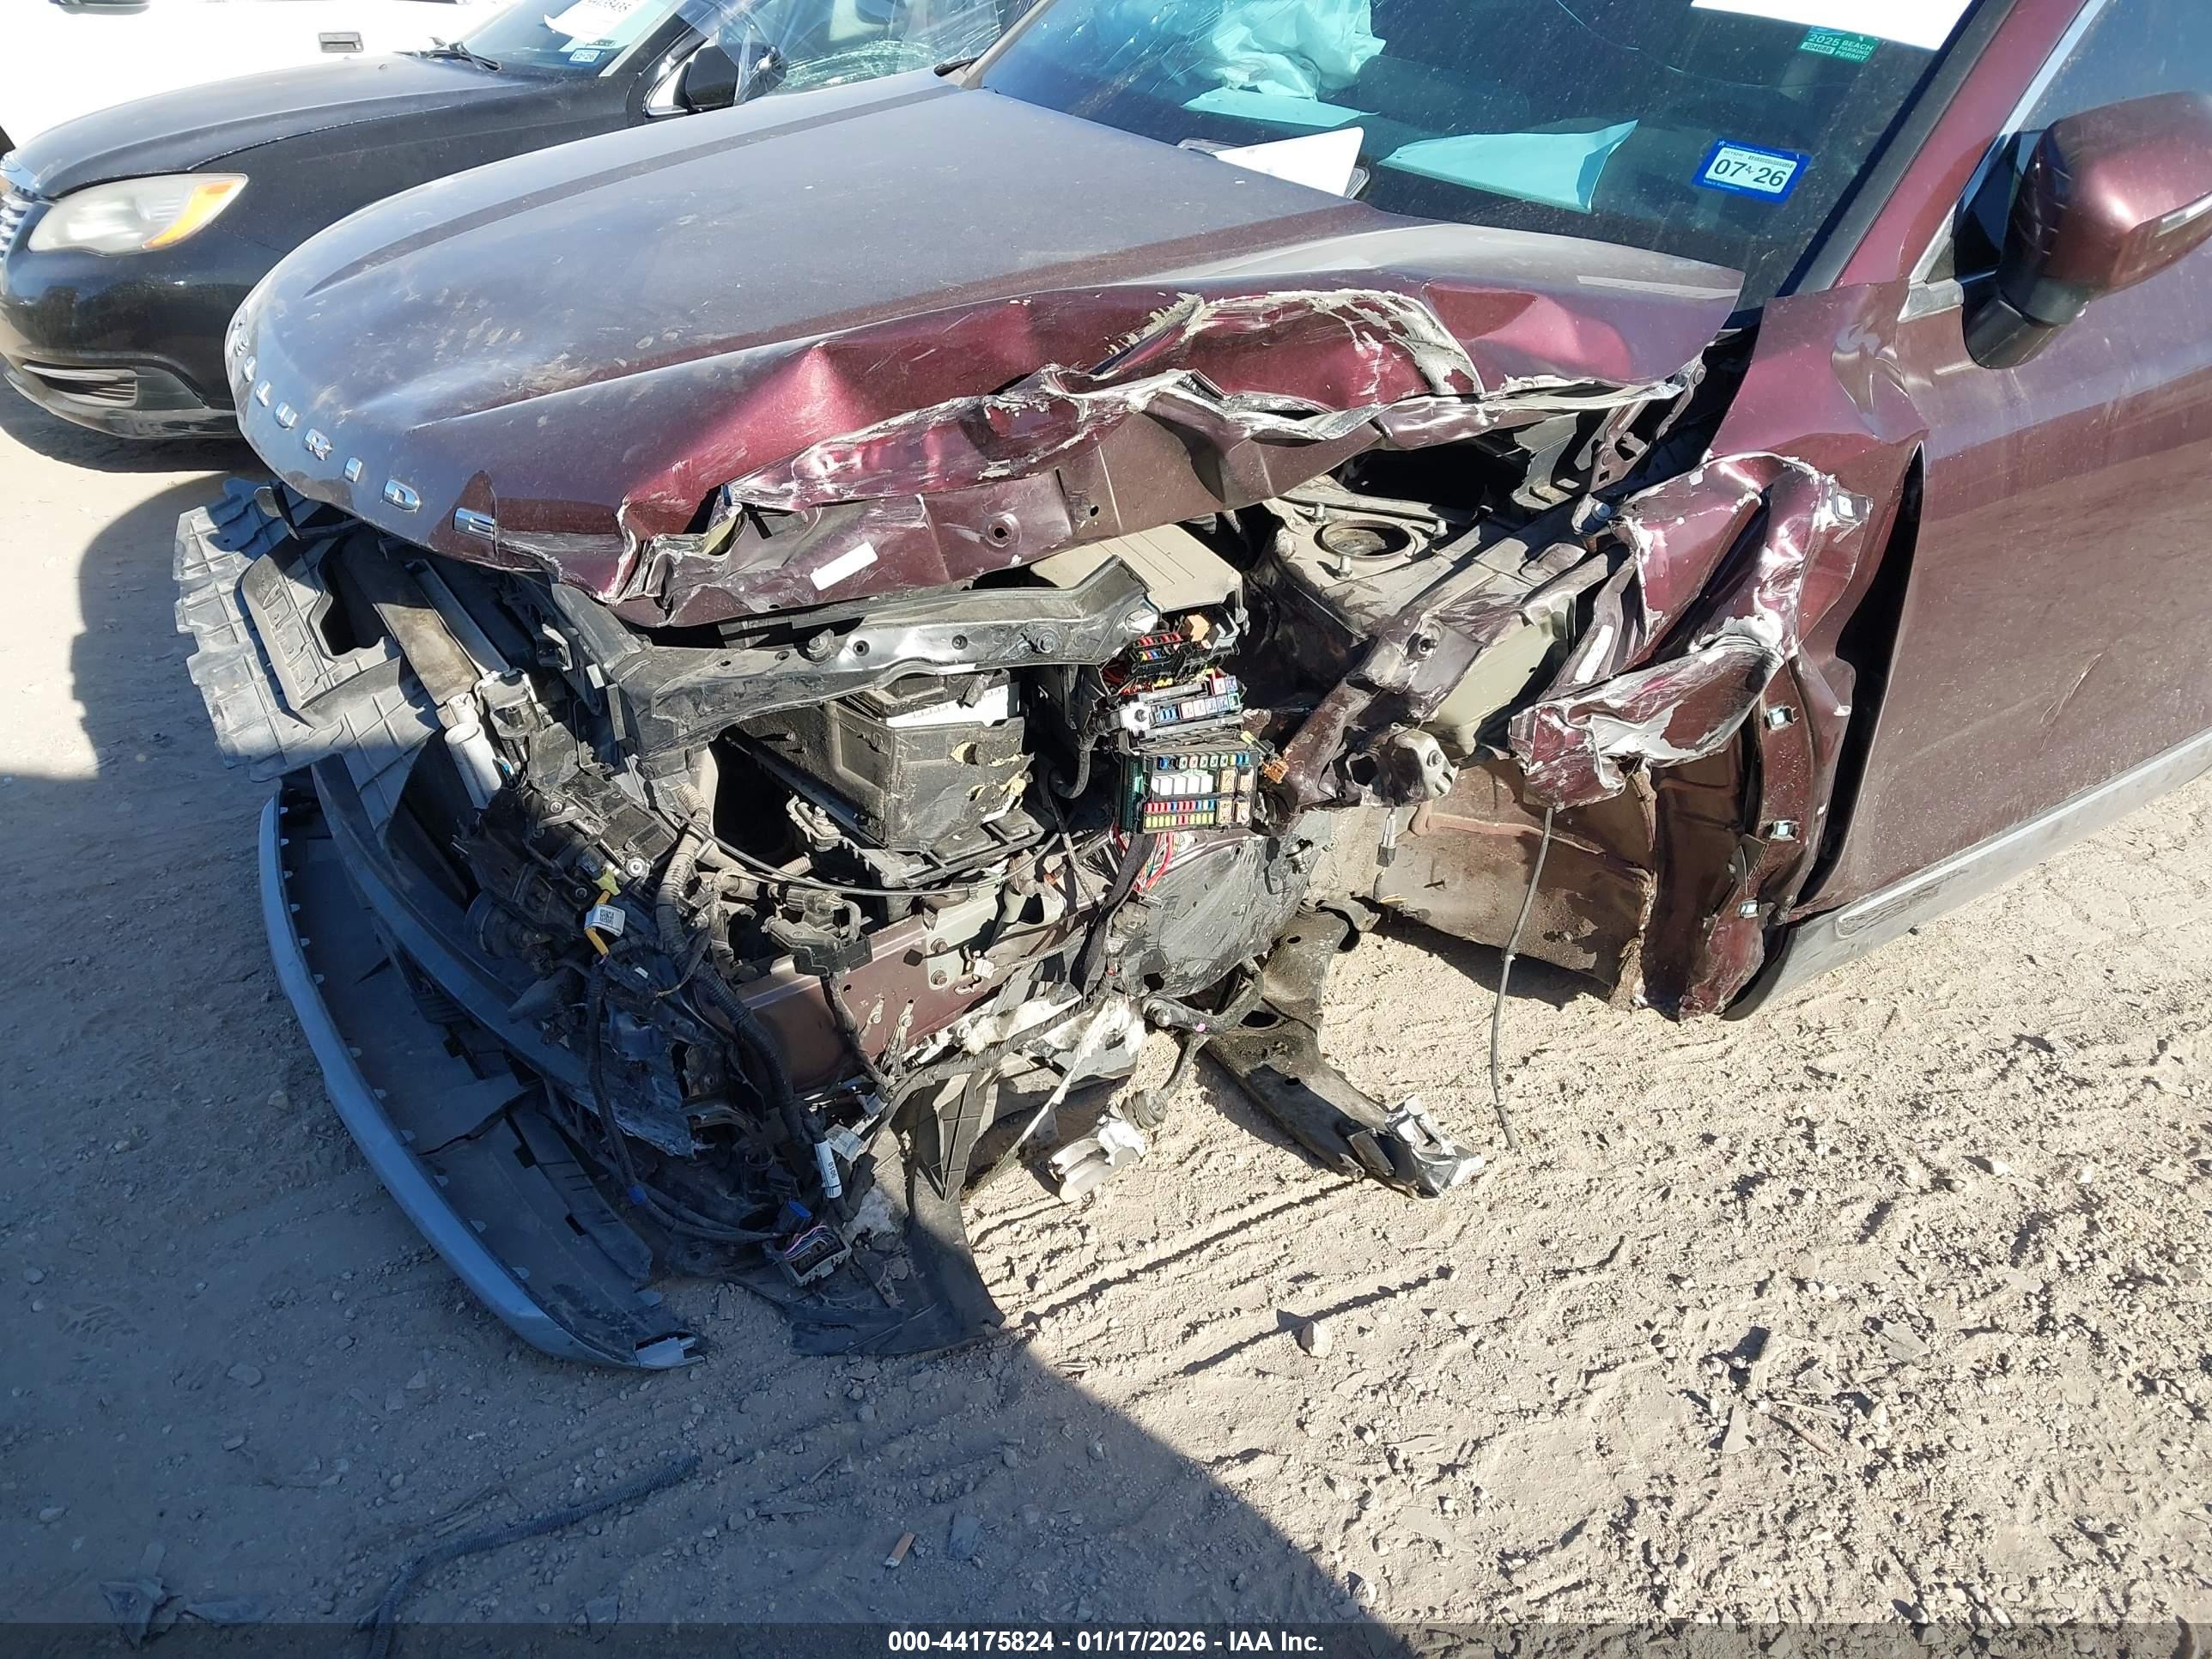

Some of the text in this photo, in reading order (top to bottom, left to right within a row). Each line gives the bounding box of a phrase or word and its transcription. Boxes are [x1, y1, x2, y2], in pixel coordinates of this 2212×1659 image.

[1808, 34, 1875, 52] 2025 BEACH
[1834, 51, 1867, 62] PERMIT
[1838, 46, 1870, 56] PARKING
[1714, 159, 1747, 177] 07
[1753, 167, 1787, 186] 26
